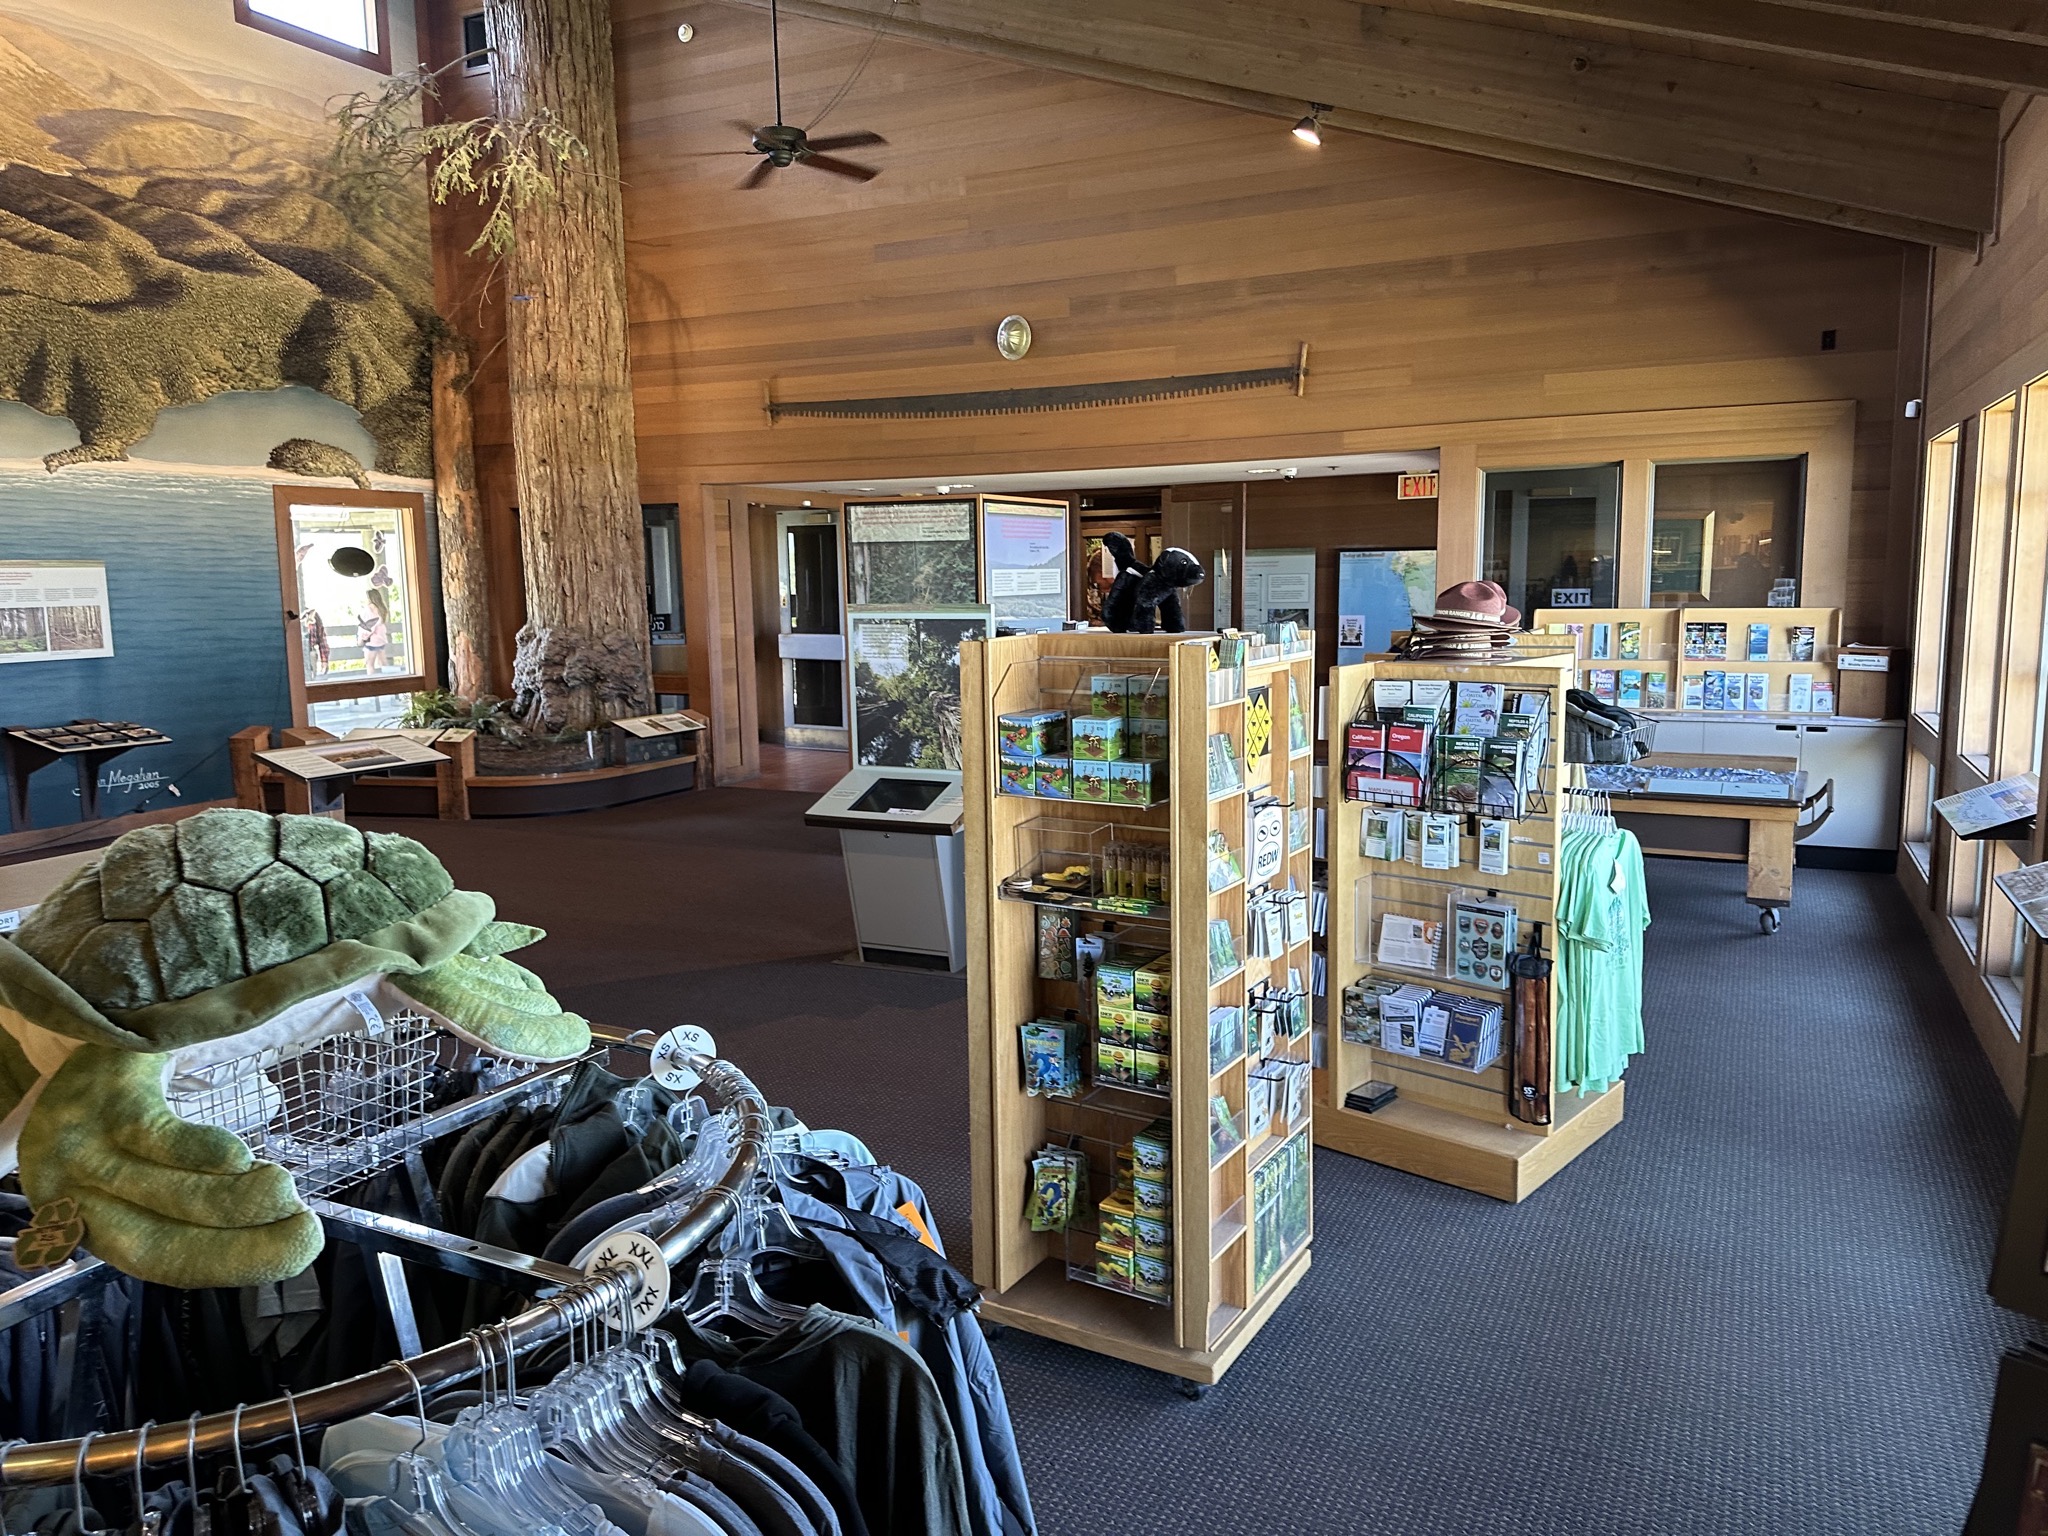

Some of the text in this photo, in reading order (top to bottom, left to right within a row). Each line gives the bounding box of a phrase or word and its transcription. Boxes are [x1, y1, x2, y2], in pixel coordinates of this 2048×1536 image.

[1403, 476, 1436, 497] EXIT
[1554, 592, 1589, 604] EXIT
[1391, 733, 1411, 741] Oregon
[138, 781, 160, 790] 2005
[1258, 849, 1279, 869] REDW
[683, 1031, 699, 1042] XS
[657, 1043, 671, 1060] XS
[665, 1072, 683, 1083] XS
[628, 1241, 654, 1270] XXL
[634, 1286, 659, 1316] XXL
